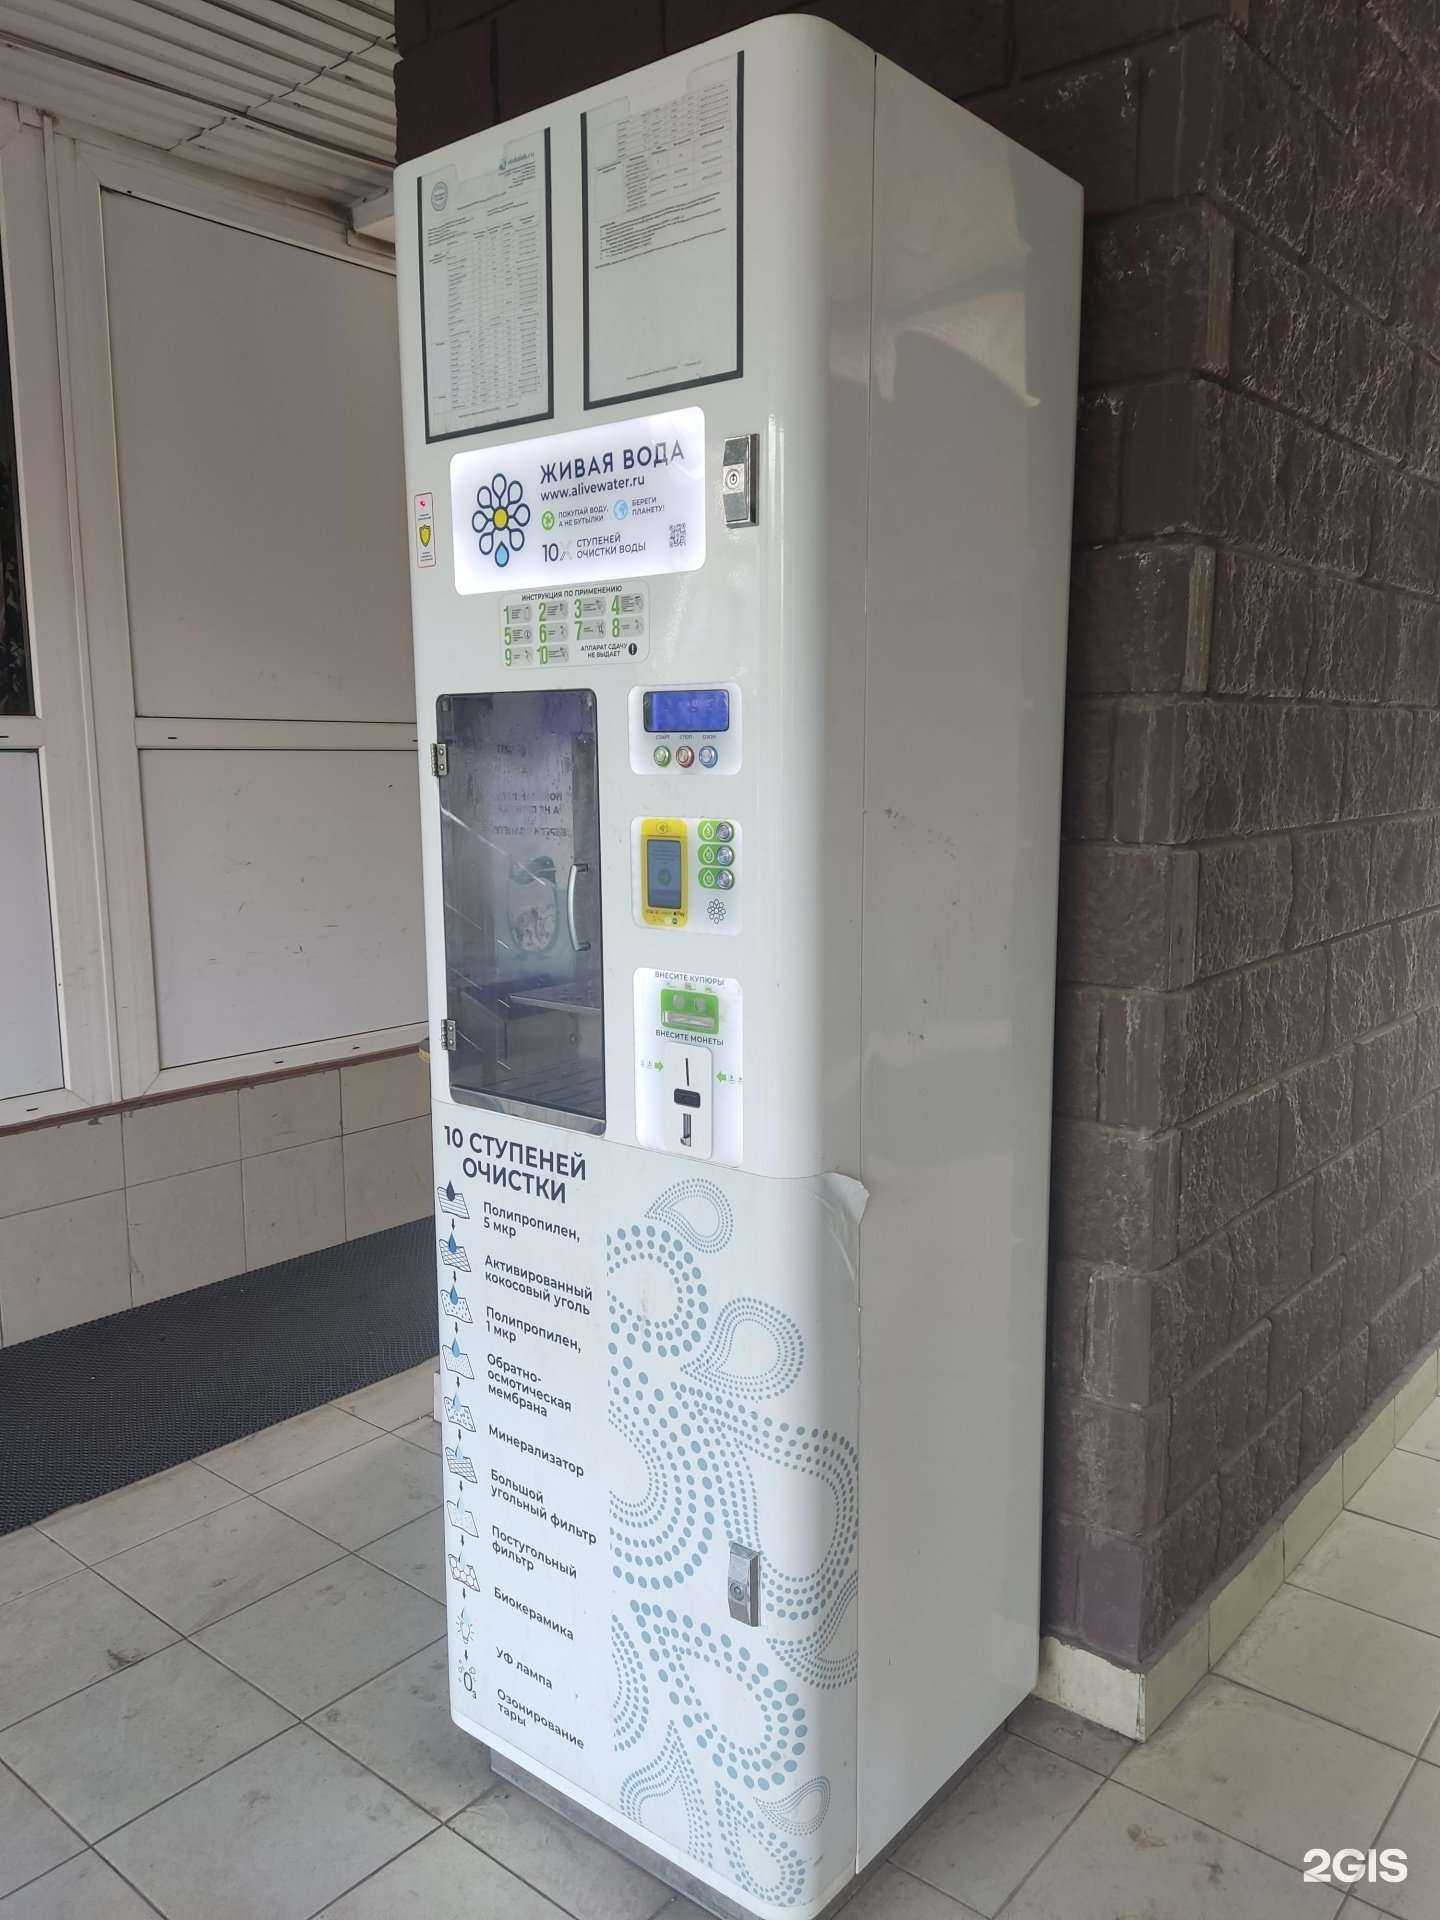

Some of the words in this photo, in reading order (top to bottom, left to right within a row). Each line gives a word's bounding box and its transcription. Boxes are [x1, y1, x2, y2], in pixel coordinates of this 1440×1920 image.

[540, 452, 614, 484] ЖИВАЯ
[623, 440, 685, 468] ВОДА
[540, 475, 645, 501] www.alivewater.ru
[558, 507, 588, 518] ПОКУПАЙ
[632, 497, 657, 507] БЕРЕГИ
[632, 504, 665, 516] ПЛАНЕТУ!
[558, 519, 563, 527] А
[564, 518, 573, 526] НЕ
[573, 515, 604, 526] БУТЫЛКИ
[576, 532, 621, 548] СТУПЕНЕЙ
[576, 546, 617, 559] ОЧИСТКИ
[619, 542, 646, 554] ВОДЫ
[521, 591, 563, 601] ИНСТРУКЦИЯ
[574, 585, 623, 596] ПРИМЕНЕНИЮ
[503, 605, 510, 625] 1
[539, 602, 547, 621] 2
[574, 599, 582, 618] 3
[611, 595, 620, 615] 4
[504, 627, 512, 646] 5
[539, 624, 547, 643] 6
[574, 621, 583, 640] 7
[612, 618, 620, 638] 8
[504, 648, 512, 667] 9
[537, 646, 548, 664] 10
[596, 650, 620, 658] ВЫДАЕТ
[655, 971, 689, 982] ВНЕСИТЕ
[690, 975, 725, 986] КУПЮРЫ
[655, 1029, 689, 1042] ВНЕСИТЕ
[690, 1036, 724, 1047] МОНЕТЫ
[444, 1125, 464, 1149] 10
[469, 1132, 587, 1181] СТУПЕНЕЙ
[462, 1157, 567, 1204] ОЧИСТКИ
[483, 1201, 580, 1243] Полипропилен,
[483, 1217, 490, 1229] 5
[493, 1222, 517, 1238] мкр
[484, 1255, 593, 1301] Активированный
[485, 1271, 551, 1303] кокосовый
[553, 1295, 591, 1316] уголь
[485, 1320, 491, 1332] 1
[493, 1327, 517, 1343] мкр
[486, 1306, 581, 1354] Полипропилен,
[487, 1353, 542, 1383] Обратно-
[487, 1370, 572, 1413] осмотическая
[488, 1384, 548, 1417] мембрана
[488, 1424, 585, 1478] Минерализатор
[490, 1468, 544, 1504] Большой
[491, 1485, 547, 1521] угольный
[550, 1513, 597, 1546] фильтр
[492, 1524, 577, 1579] Постугольный
[492, 1540, 535, 1571] фильтр
[494, 1586, 574, 1641] Биокерамика
[495, 1646, 514, 1665] УФ
[516, 1662, 553, 1690] лампа
[497, 1702, 526, 1727] тары
[497, 1688, 585, 1750] Озонирование
